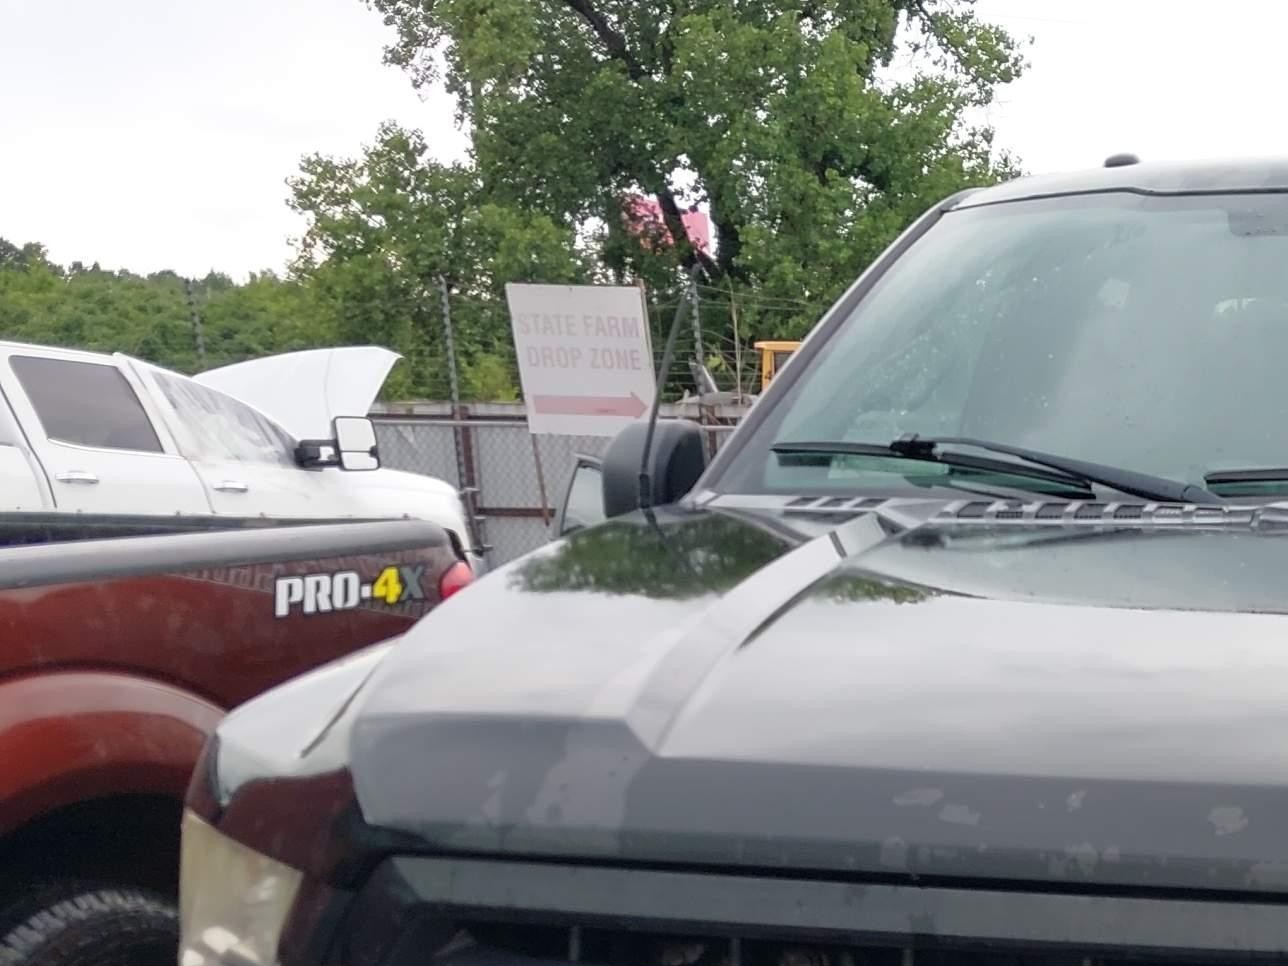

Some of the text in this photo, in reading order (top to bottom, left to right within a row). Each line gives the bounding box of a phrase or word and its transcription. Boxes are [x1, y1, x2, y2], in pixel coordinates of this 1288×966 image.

[518, 314, 640, 338] STATE FARM
[528, 346, 641, 370] DROP ZONE
[275, 565, 425, 618] PRO-4X
